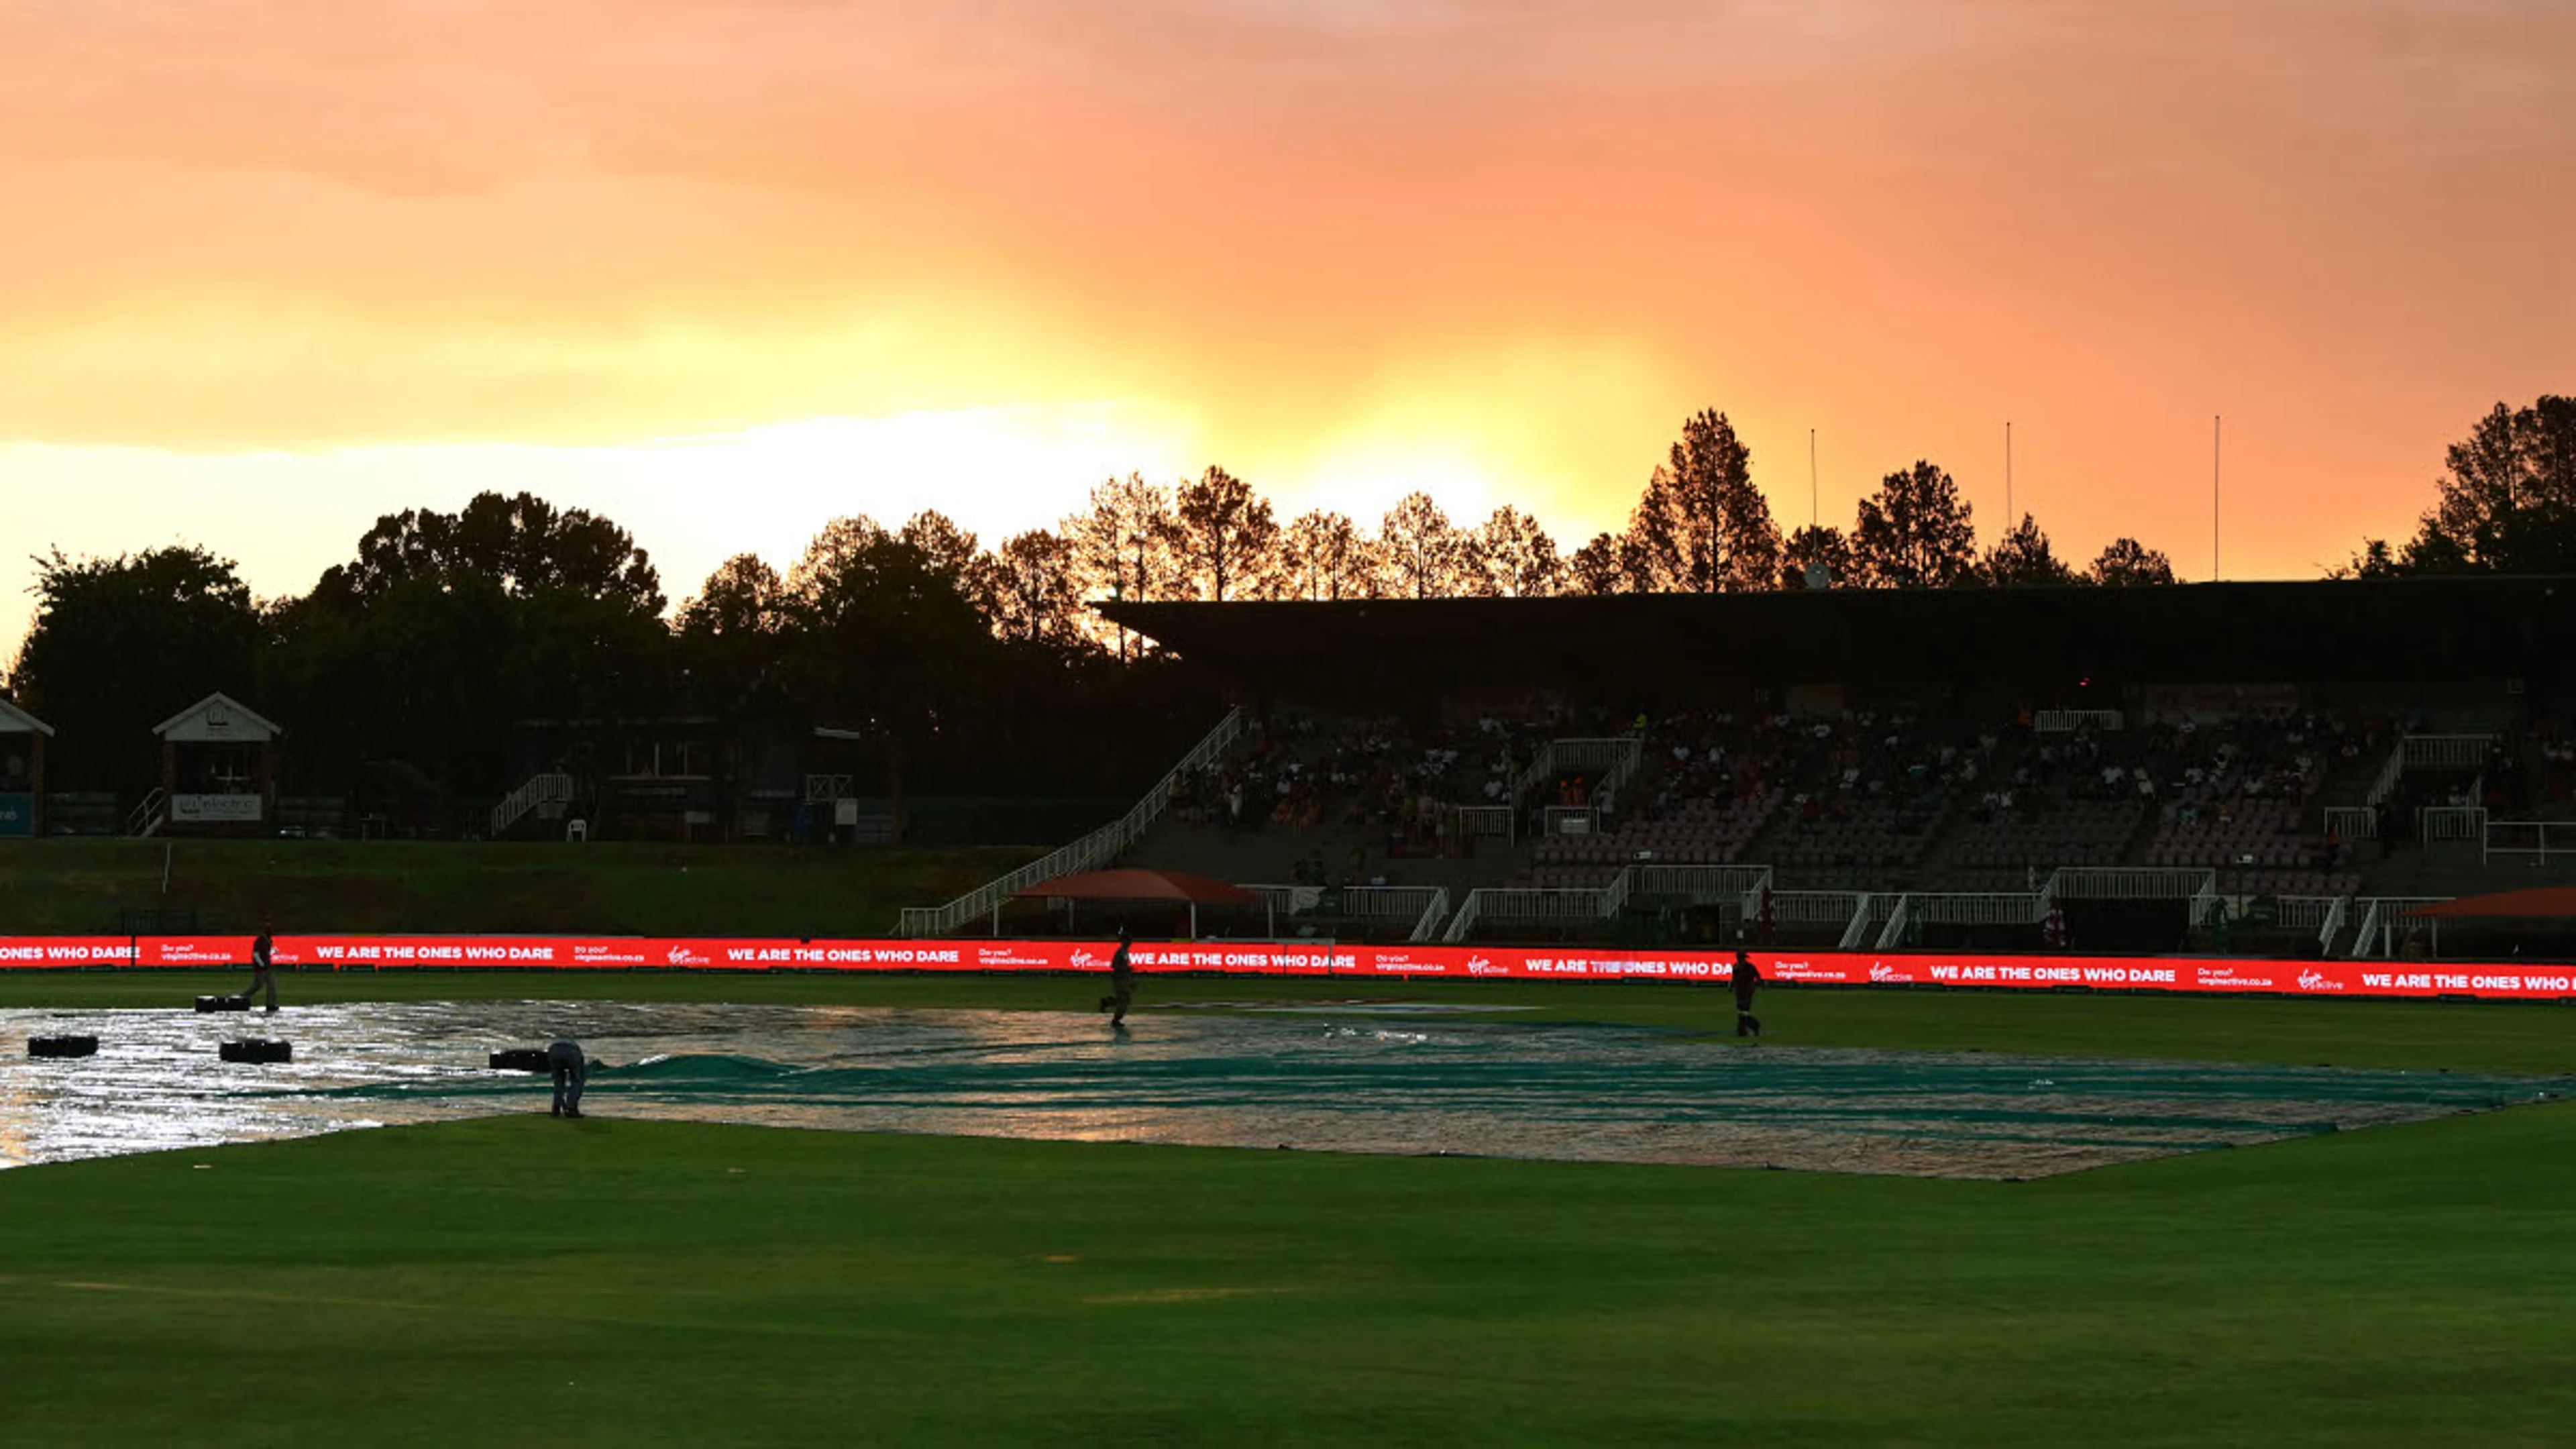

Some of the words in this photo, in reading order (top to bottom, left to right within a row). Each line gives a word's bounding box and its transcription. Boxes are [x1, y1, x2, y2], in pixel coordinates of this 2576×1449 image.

[0, 947, 44, 959] ONES
[46, 947, 89, 959] WHO
[91, 947, 141, 959] DARE
[316, 946, 344, 958] WE
[347, 946, 380, 959] ARE
[383, 947, 415, 959] THE
[417, 947, 462, 959] ONES
[465, 947, 507, 959] WHO
[508, 947, 553, 959] DARE
[727, 948, 755, 961] WE
[757, 949, 791, 961] ARE
[794, 949, 825, 961] THE
[826, 949, 872, 961] ONES
[873, 950, 914, 962] WHO
[916, 950, 959, 962] DARE
[1128, 953, 1155, 965] WE
[1157, 953, 1190, 965] ARE
[1191, 953, 1222, 966] THE
[1225, 953, 1269, 966] ONES
[1270, 954, 1308, 967] WHO
[1310, 955, 1356, 967] DARE
[1525, 959, 1552, 971] WE
[1554, 959, 1587, 972] ARE
[1589, 960, 1621, 973] THE
[1623, 960, 1666, 974] ONES
[1669, 961, 1709, 975] WHO
[1711, 962, 1733, 975] DA
[1930, 966, 1959, 979] WE
[1961, 966, 1996, 979] ARE
[1998, 967, 2031, 979] THE
[2033, 967, 2081, 980] ONES
[2084, 967, 2127, 981] WHO
[2129, 969, 2176, 982] DARE
[2361, 973, 2392, 987] WE
[2394, 974, 2431, 987] ARE
[2434, 975, 2469, 988] THE
[2471, 975, 2521, 989] ONES
[2524, 976, 2570, 990] WHO
